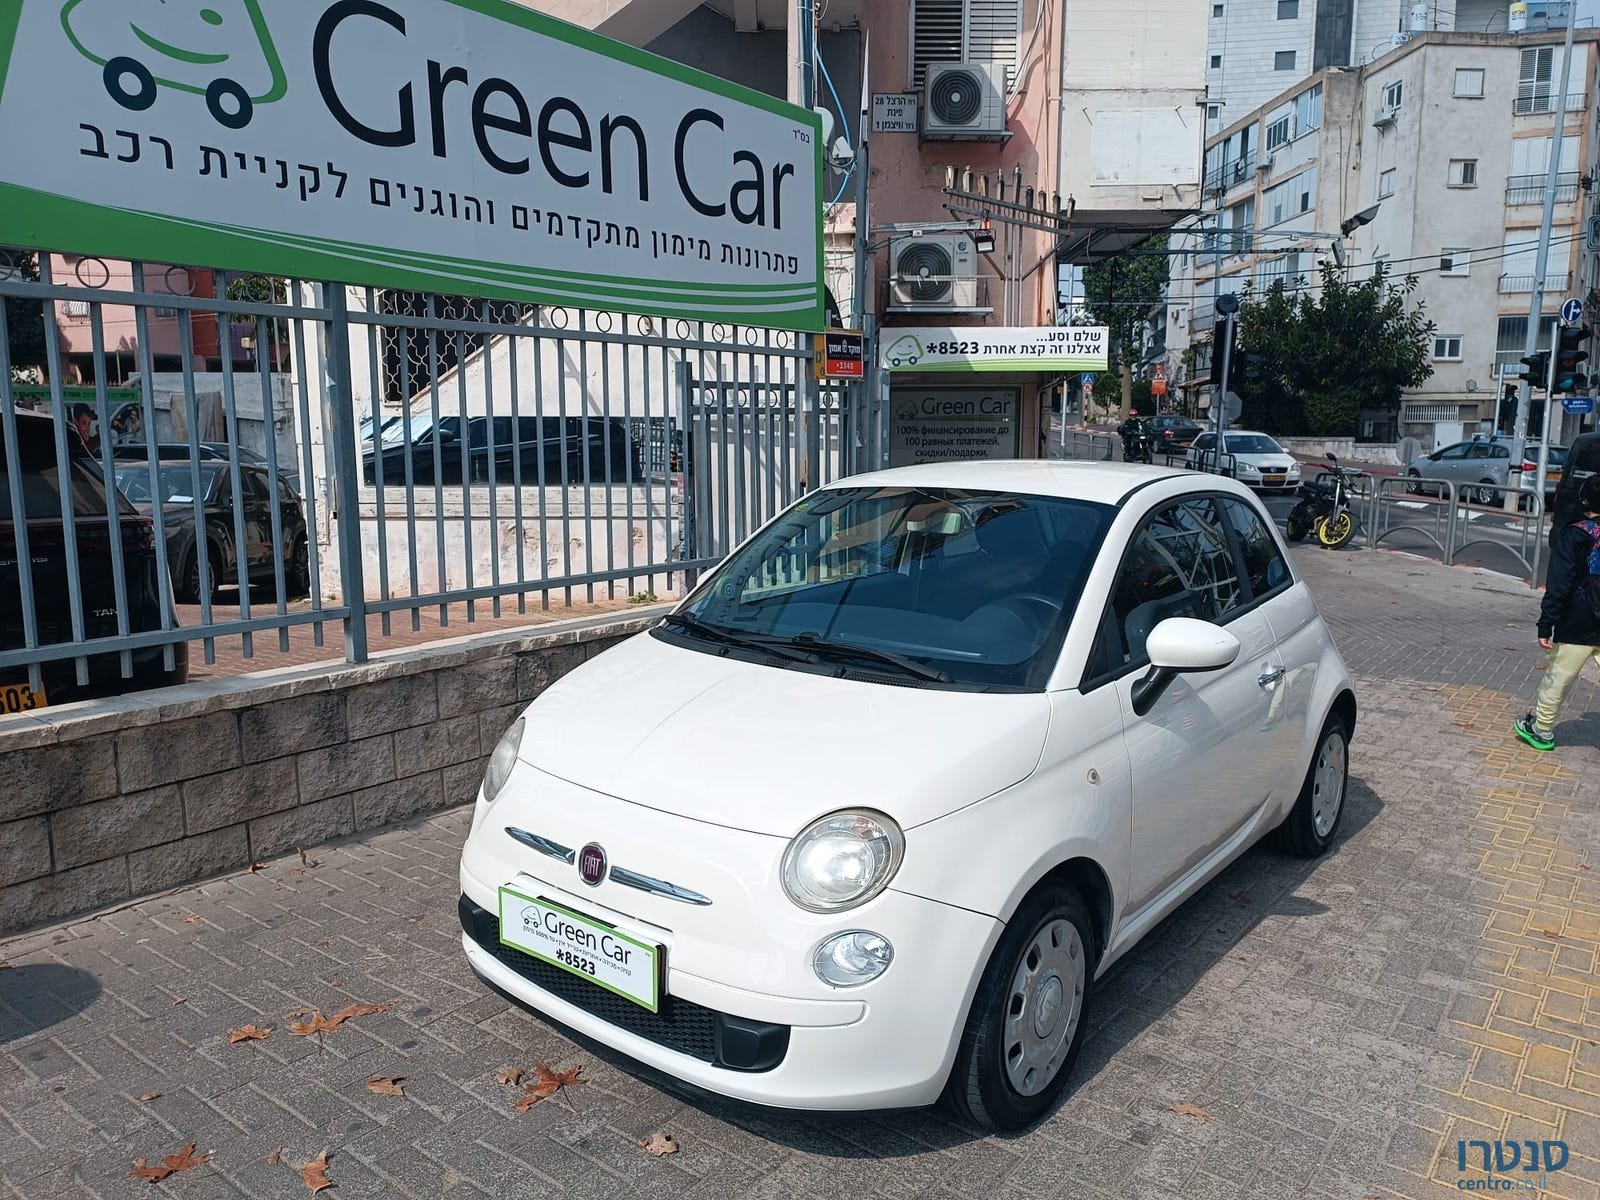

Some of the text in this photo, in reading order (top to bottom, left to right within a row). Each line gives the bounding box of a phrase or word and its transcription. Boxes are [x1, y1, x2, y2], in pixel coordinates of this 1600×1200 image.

[875, 97, 885, 105] 28
[886, 95, 907, 106] הרצל
[313, 0, 794, 230] Green Car
[886, 108, 903, 117] פינת
[792, 129, 810, 143] בס"ד
[80, 123, 798, 275] פתרונות מימון מתקדמים והוגנים לקניית רכב
[1035, 330, 1101, 342] שלם וסע...
[983, 343, 1101, 357] אצלנו זה קצת אחרת
[921, 397, 1010, 415] Green Car
[896, 424, 1010, 436] 100% финансирование до
[905, 437, 920, 446] 100
[922, 439, 953, 447] равных
[94, 609, 118, 617] TAN
[0, 686, 35, 713] 03
[584, 854, 602, 876] FIAT
[544, 912, 632, 965] Green Car
